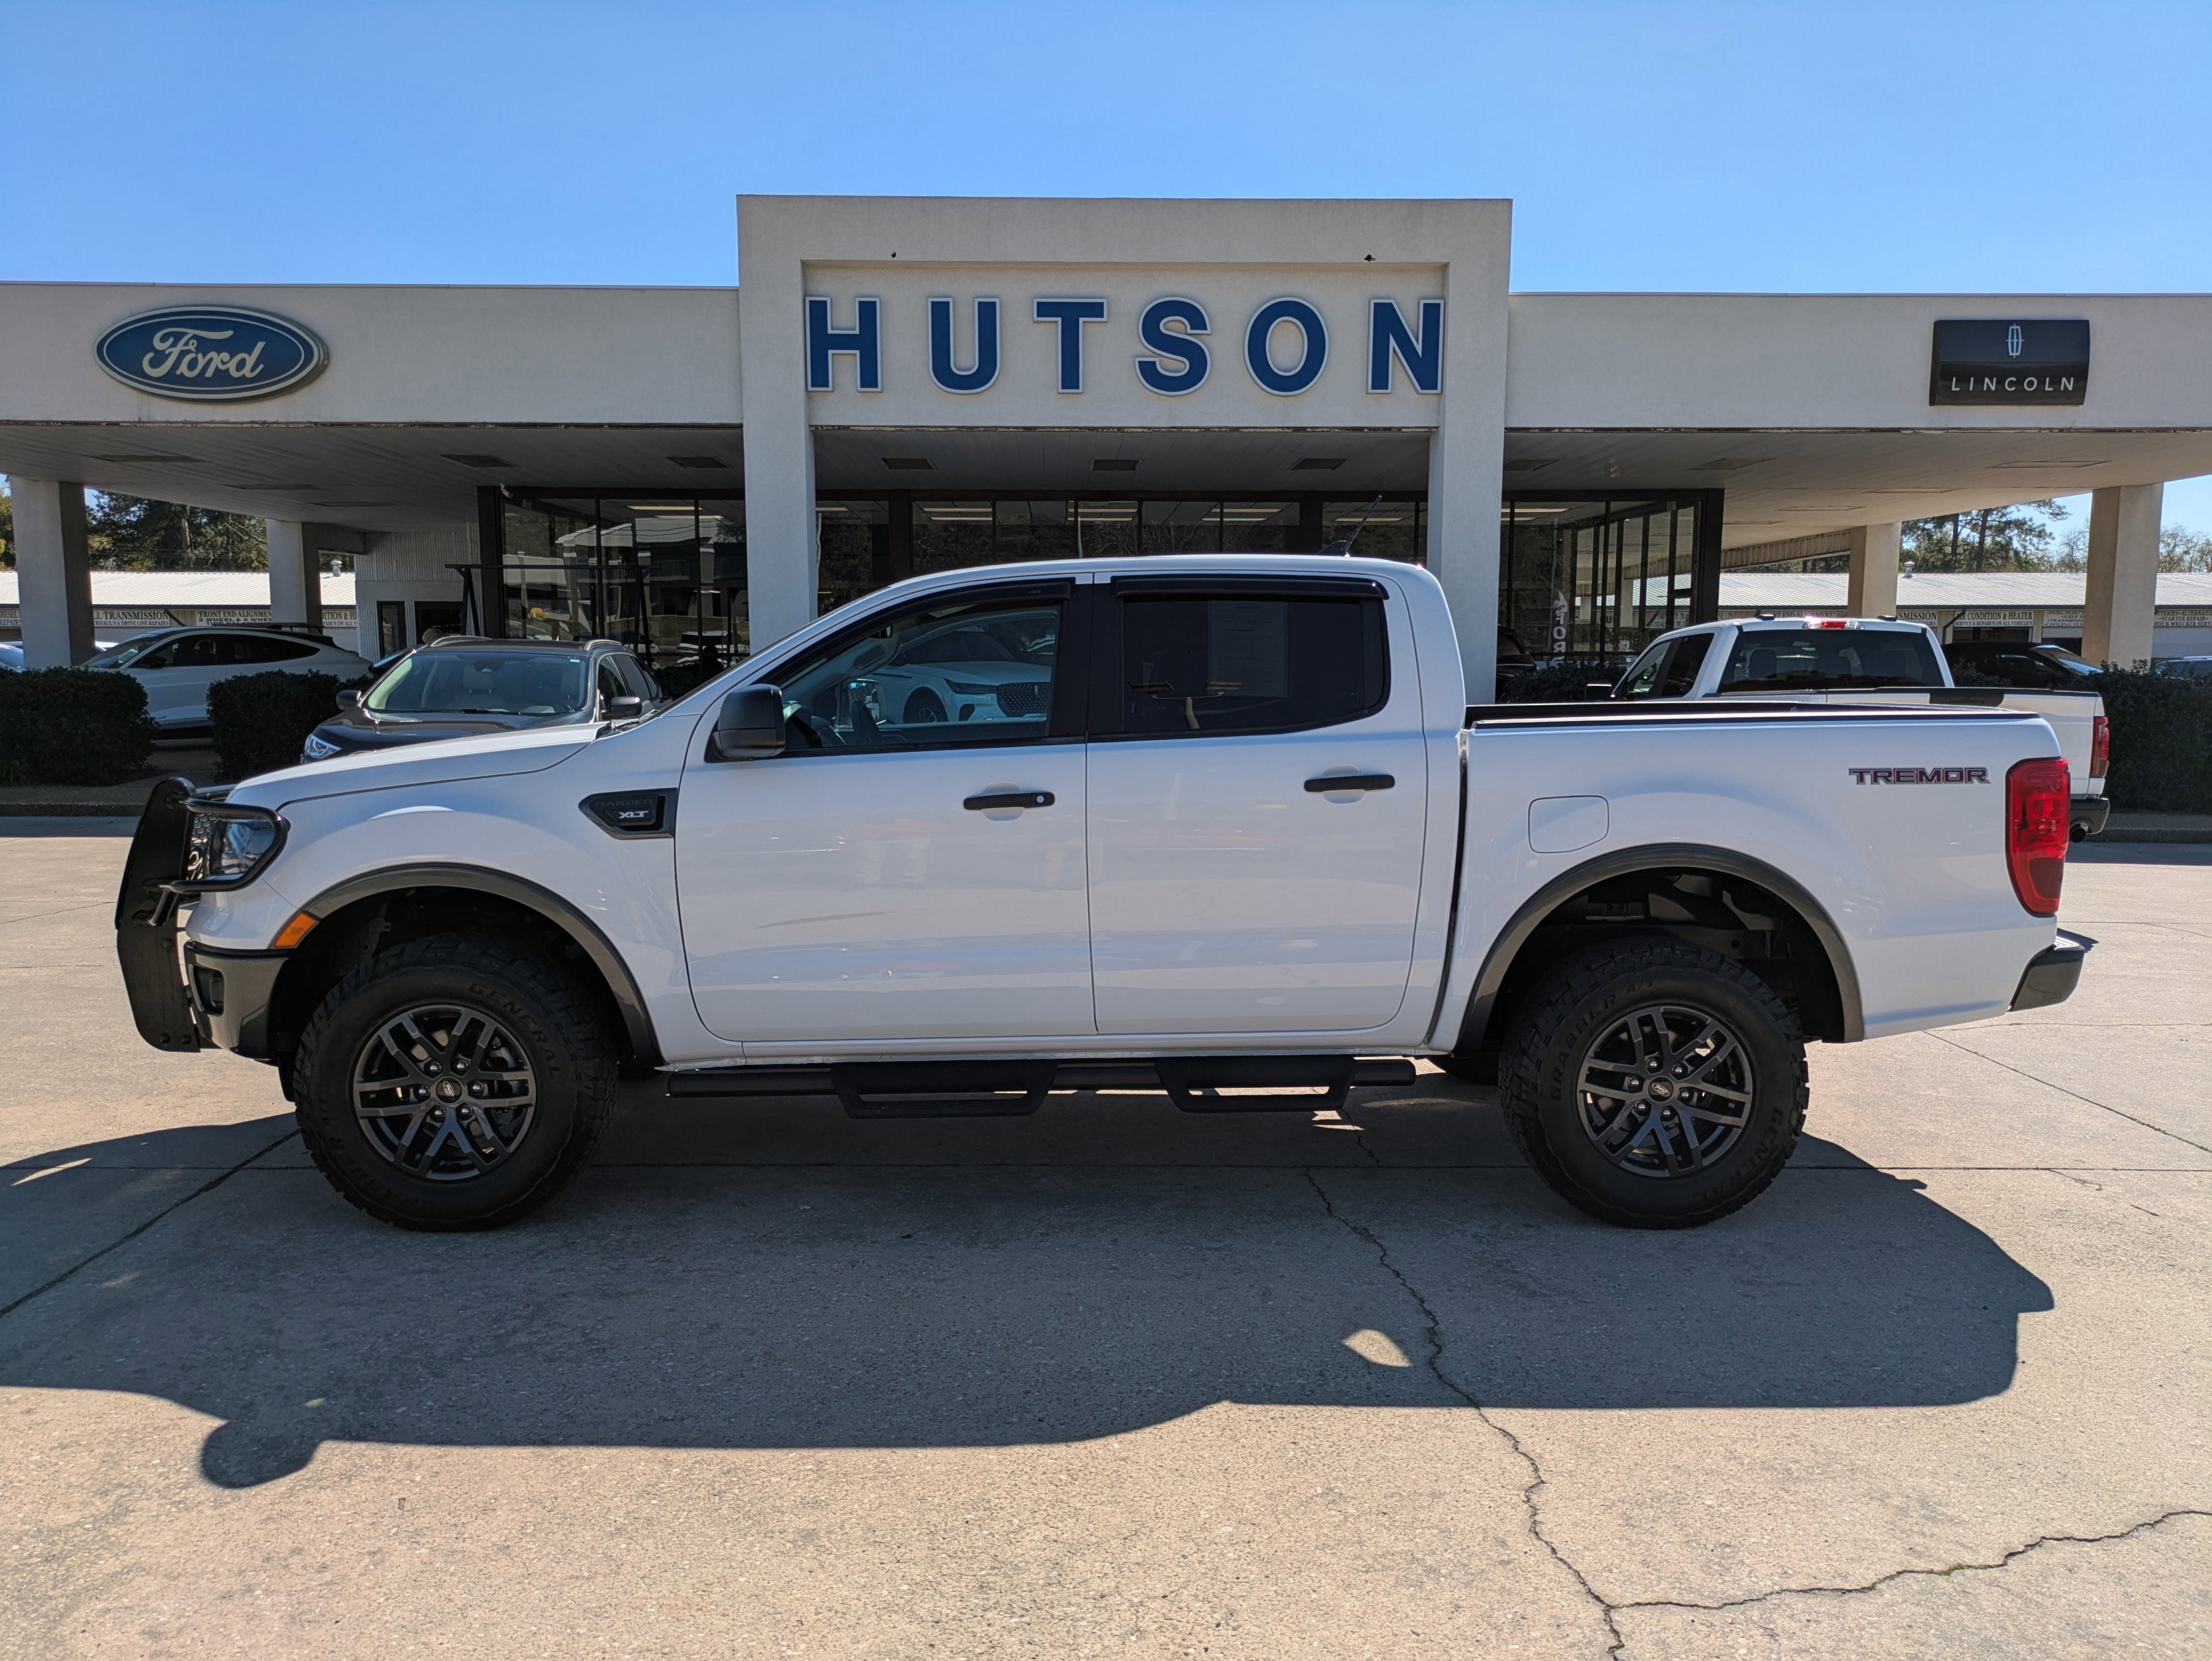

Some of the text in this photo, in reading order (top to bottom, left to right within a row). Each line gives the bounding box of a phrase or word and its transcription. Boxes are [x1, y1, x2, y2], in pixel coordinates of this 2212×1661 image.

[142, 328, 266, 378] Ford
[805, 297, 1445, 396] HUTSON
[1951, 377, 2074, 391] LINCOLN
[1849, 767, 1991, 785] TREMOR
[619, 811, 649, 819] XLT
[468, 983, 560, 1080] GENERAL
[1551, 994, 1616, 1102] GRABBER
